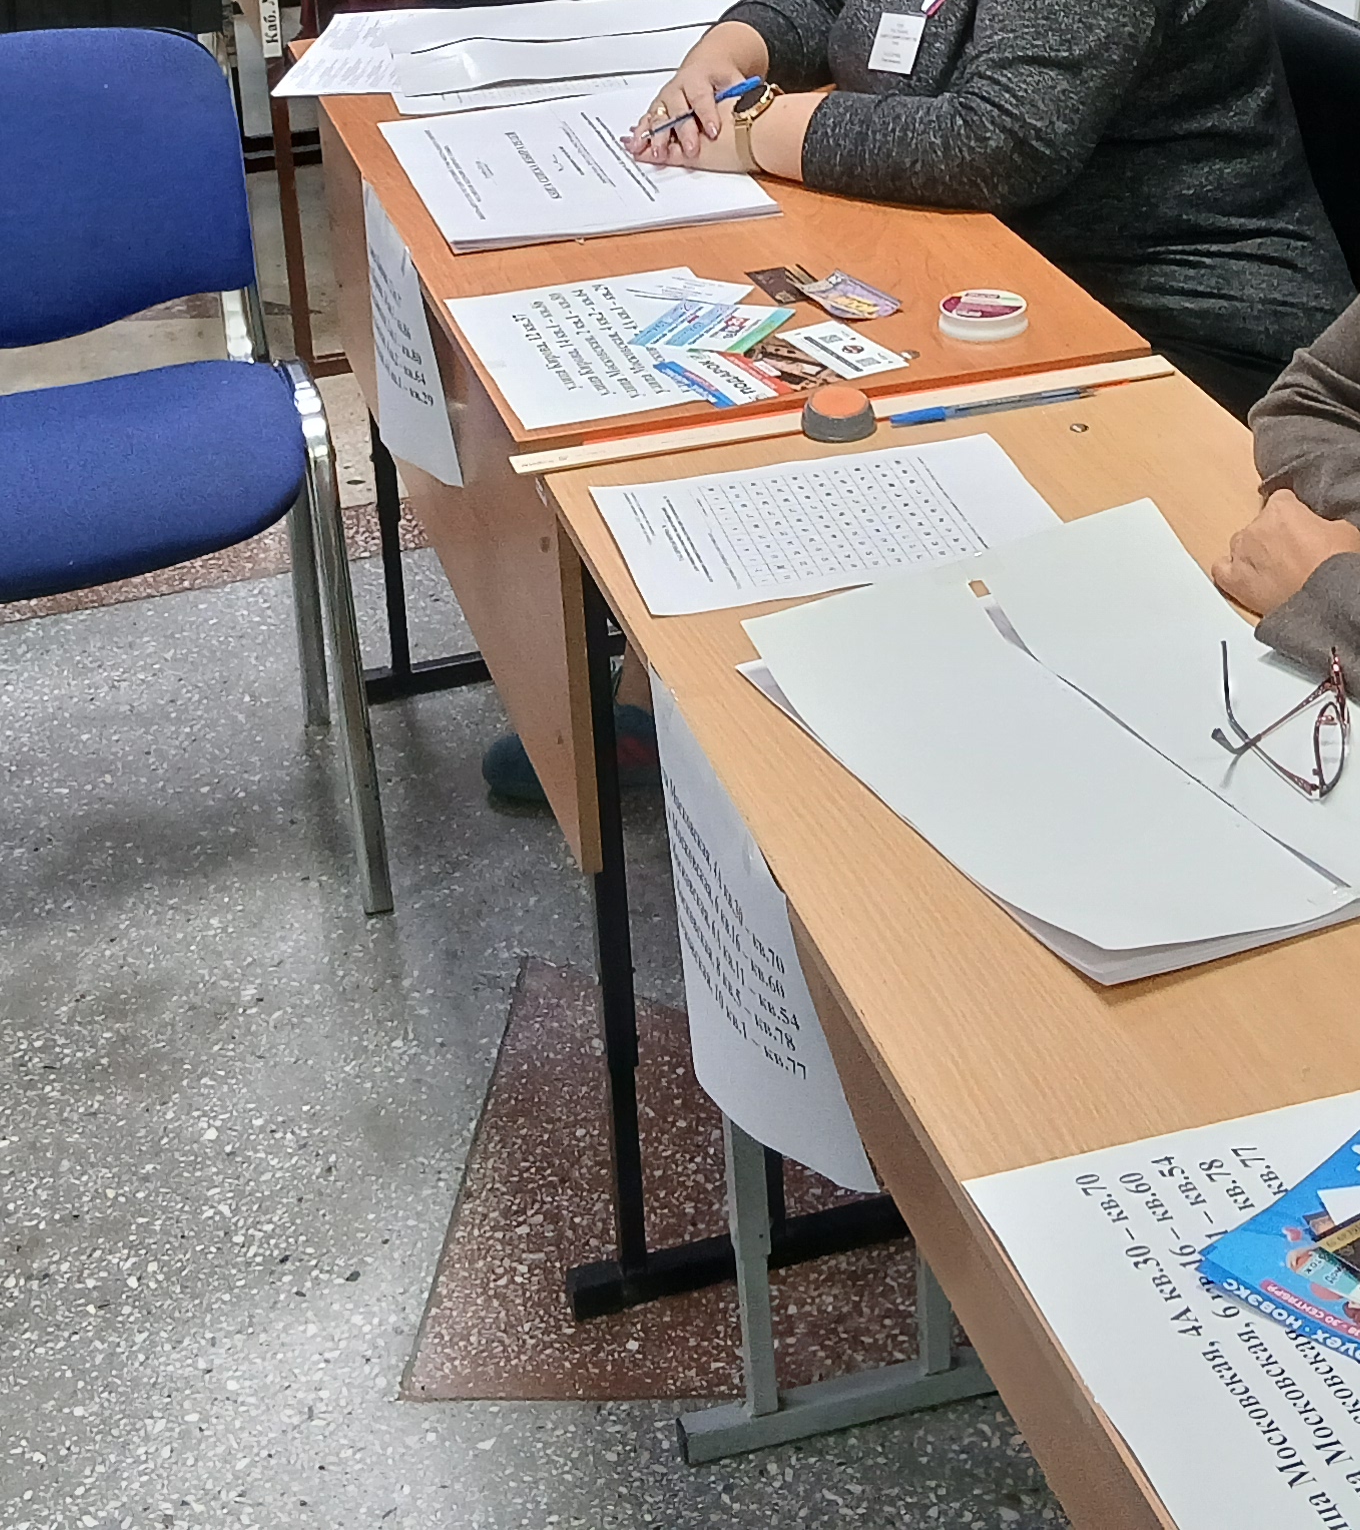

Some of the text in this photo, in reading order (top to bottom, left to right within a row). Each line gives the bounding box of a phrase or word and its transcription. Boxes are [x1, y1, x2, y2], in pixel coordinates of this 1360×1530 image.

[263, 11, 279, 44] Каб.
[699, 352, 756, 398] ПОДАРОК
[752, 932, 785, 975] кв.70
[750, 957, 785, 999] кв.60
[754, 1014, 796, 1052] кв.78
[758, 993, 800, 1032] кв.54
[764, 1045, 807, 1080] кв.77
[1150, 1155, 1208, 1208] кв.54
[1198, 1158, 1256, 1213] кв.78
[1231, 1145, 1289, 1197] кв.77
[1075, 1172, 1131, 1226] кв.70
[1119, 1171, 1175, 1224] кв.60
[1125, 1244, 1183, 1304] кв.30
[1169, 1305, 1204, 1338] 4А
[1222, 1278, 1304, 1331] НОВЭКС
[1266, 1282, 1325, 1322] СЕНТЯБРЯ
[1325, 1315, 1344, 1328] 30
[1201, 1339, 1318, 1491] Московская,
[1237, 1320, 1355, 1467] Московская,
